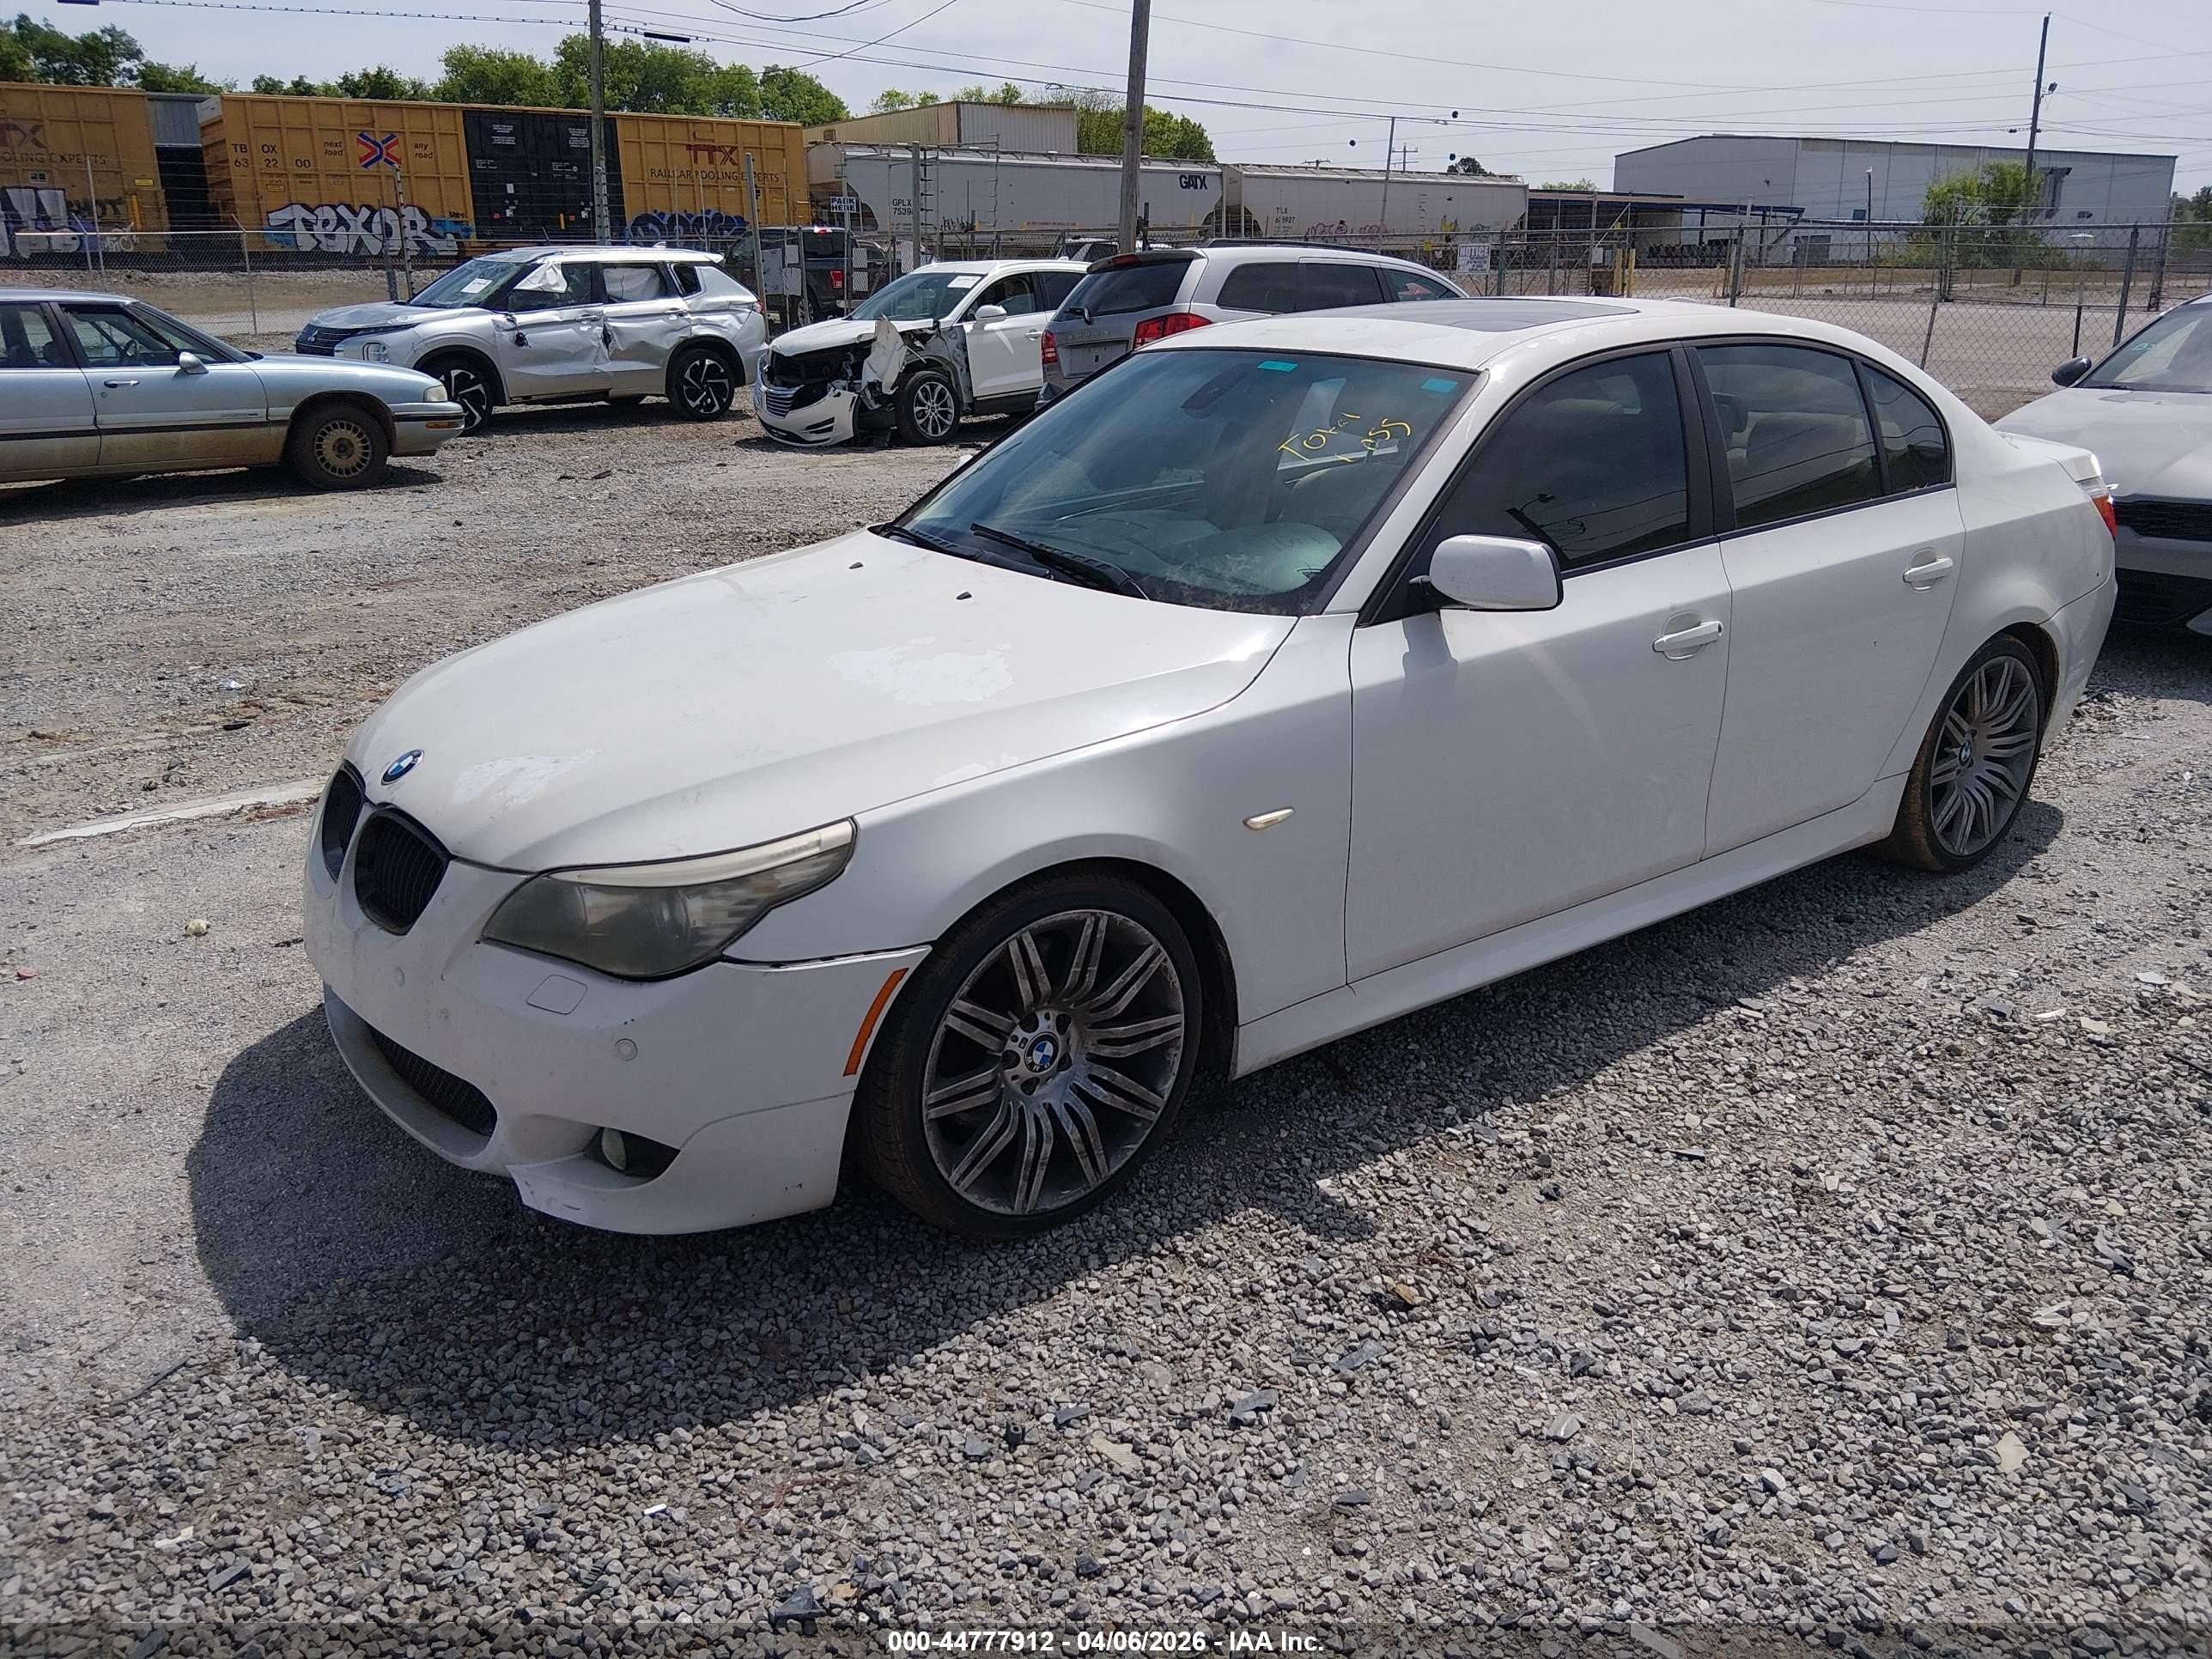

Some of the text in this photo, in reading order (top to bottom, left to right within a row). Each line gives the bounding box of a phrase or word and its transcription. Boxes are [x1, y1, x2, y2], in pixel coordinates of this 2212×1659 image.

[231, 143, 277, 154] TB OX
[234, 157, 312, 168] 63 22 00
[695, 170, 738, 181] POOLING
[741, 171, 780, 183] EPERTS
[1179, 174, 1208, 190] GATX
[892, 198, 912, 207] GPLX
[892, 207, 914, 216] 7539
[1460, 246, 1489, 257] NOTICE
